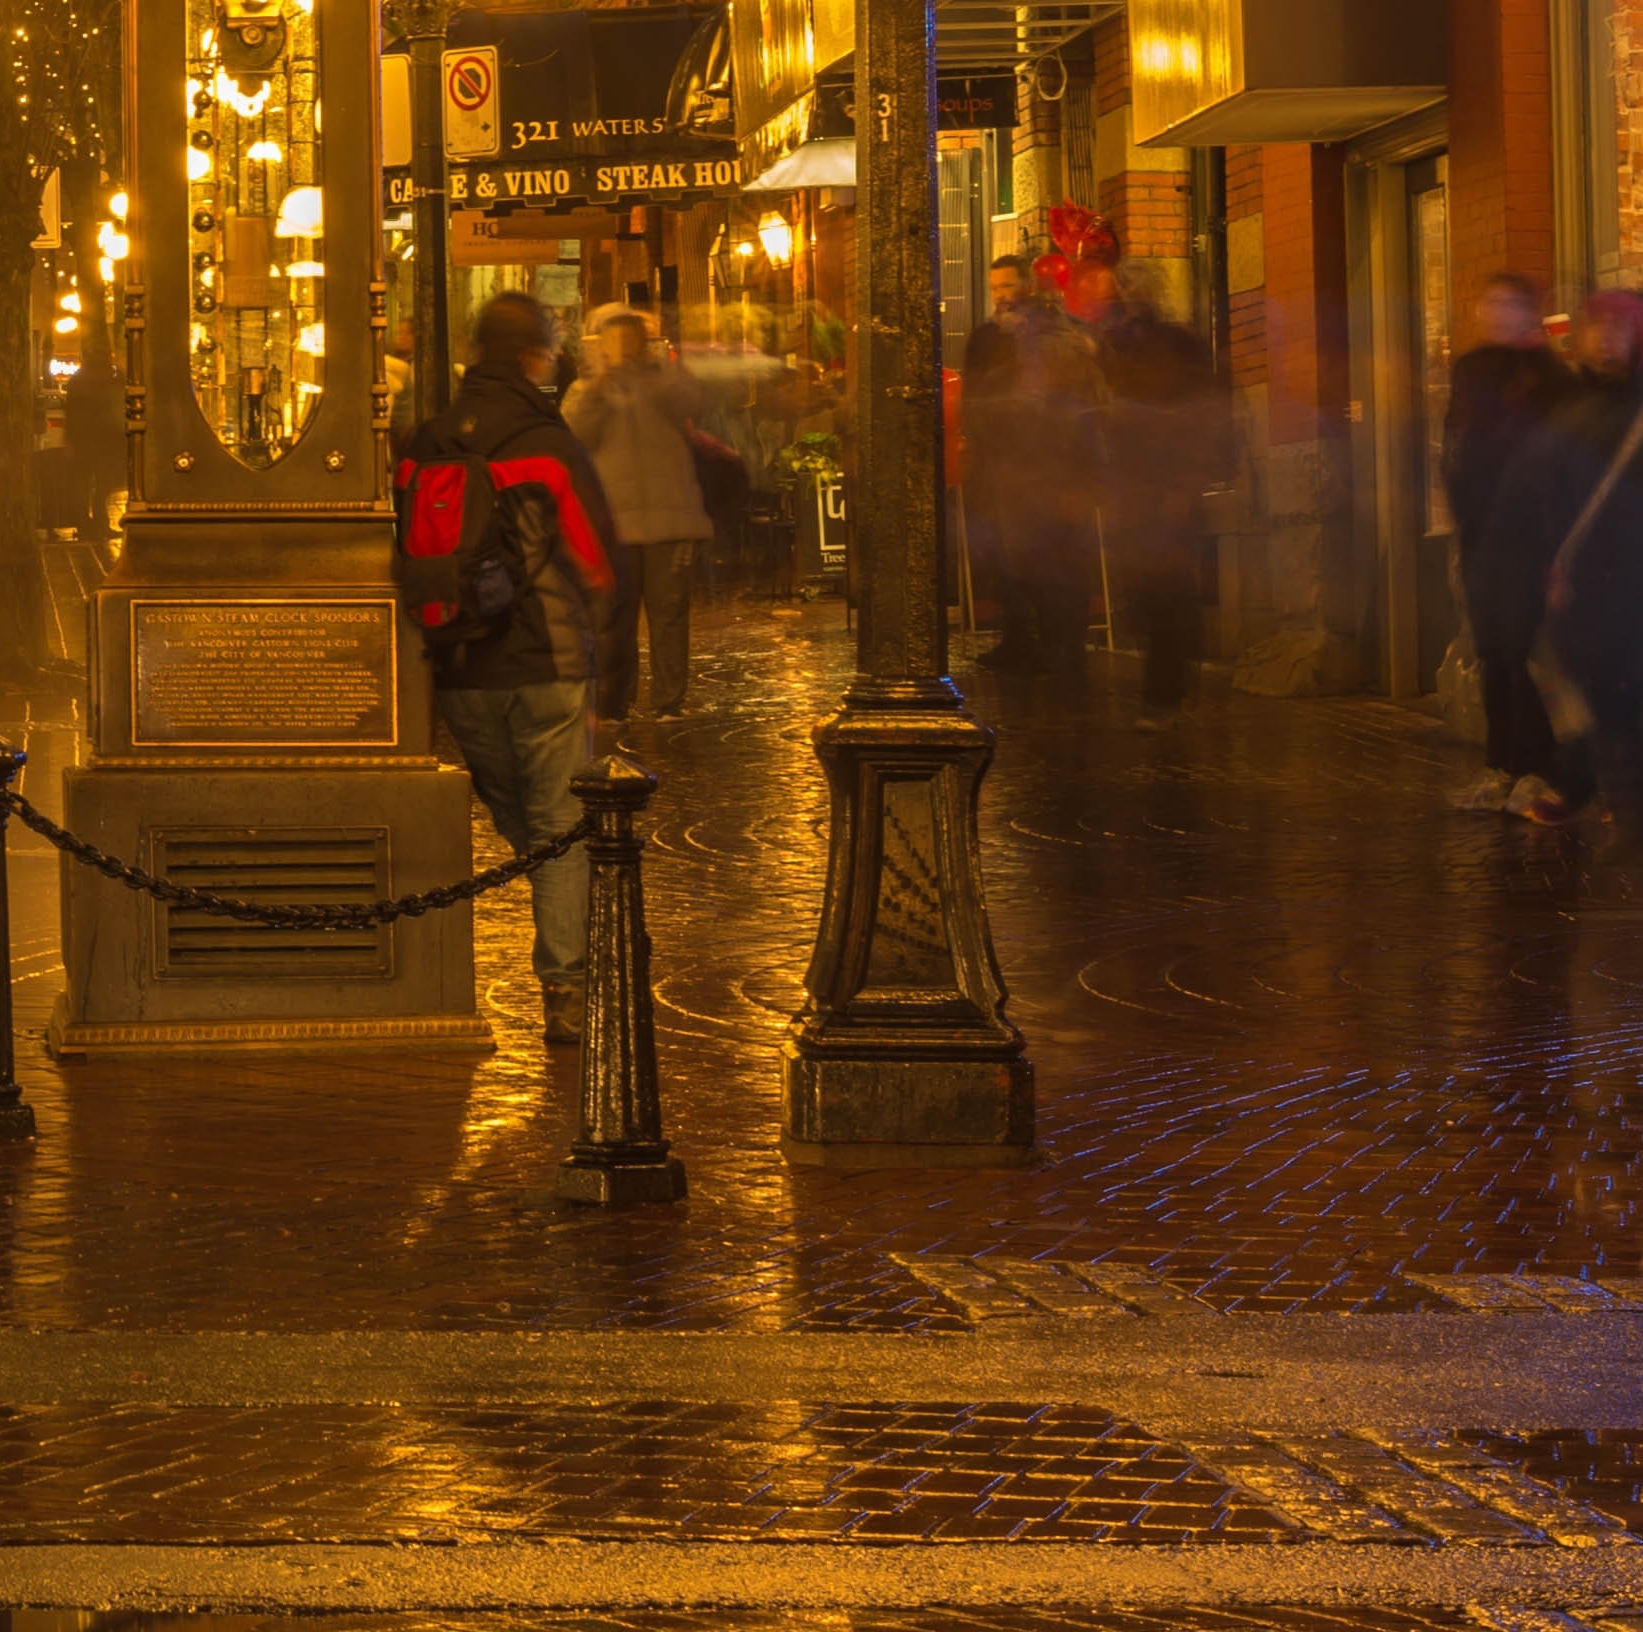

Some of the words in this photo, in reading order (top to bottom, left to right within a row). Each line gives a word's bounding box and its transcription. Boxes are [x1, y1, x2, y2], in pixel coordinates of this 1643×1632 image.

[511, 120, 560, 149] 321
[476, 173, 498, 198] &
[505, 169, 571, 197] VINO
[596, 163, 688, 192] STEAK
[820, 551, 846, 564] Tree
[146, 612, 213, 624] GASTOWN
[217, 612, 260, 624] STEAM
[264, 612, 308, 624] CLOCK
[314, 611, 380, 624] SPONSORS
[221, 650, 245, 659] CITY
[249, 650, 261, 659] OF
[266, 650, 326, 659] VANCOUVER
